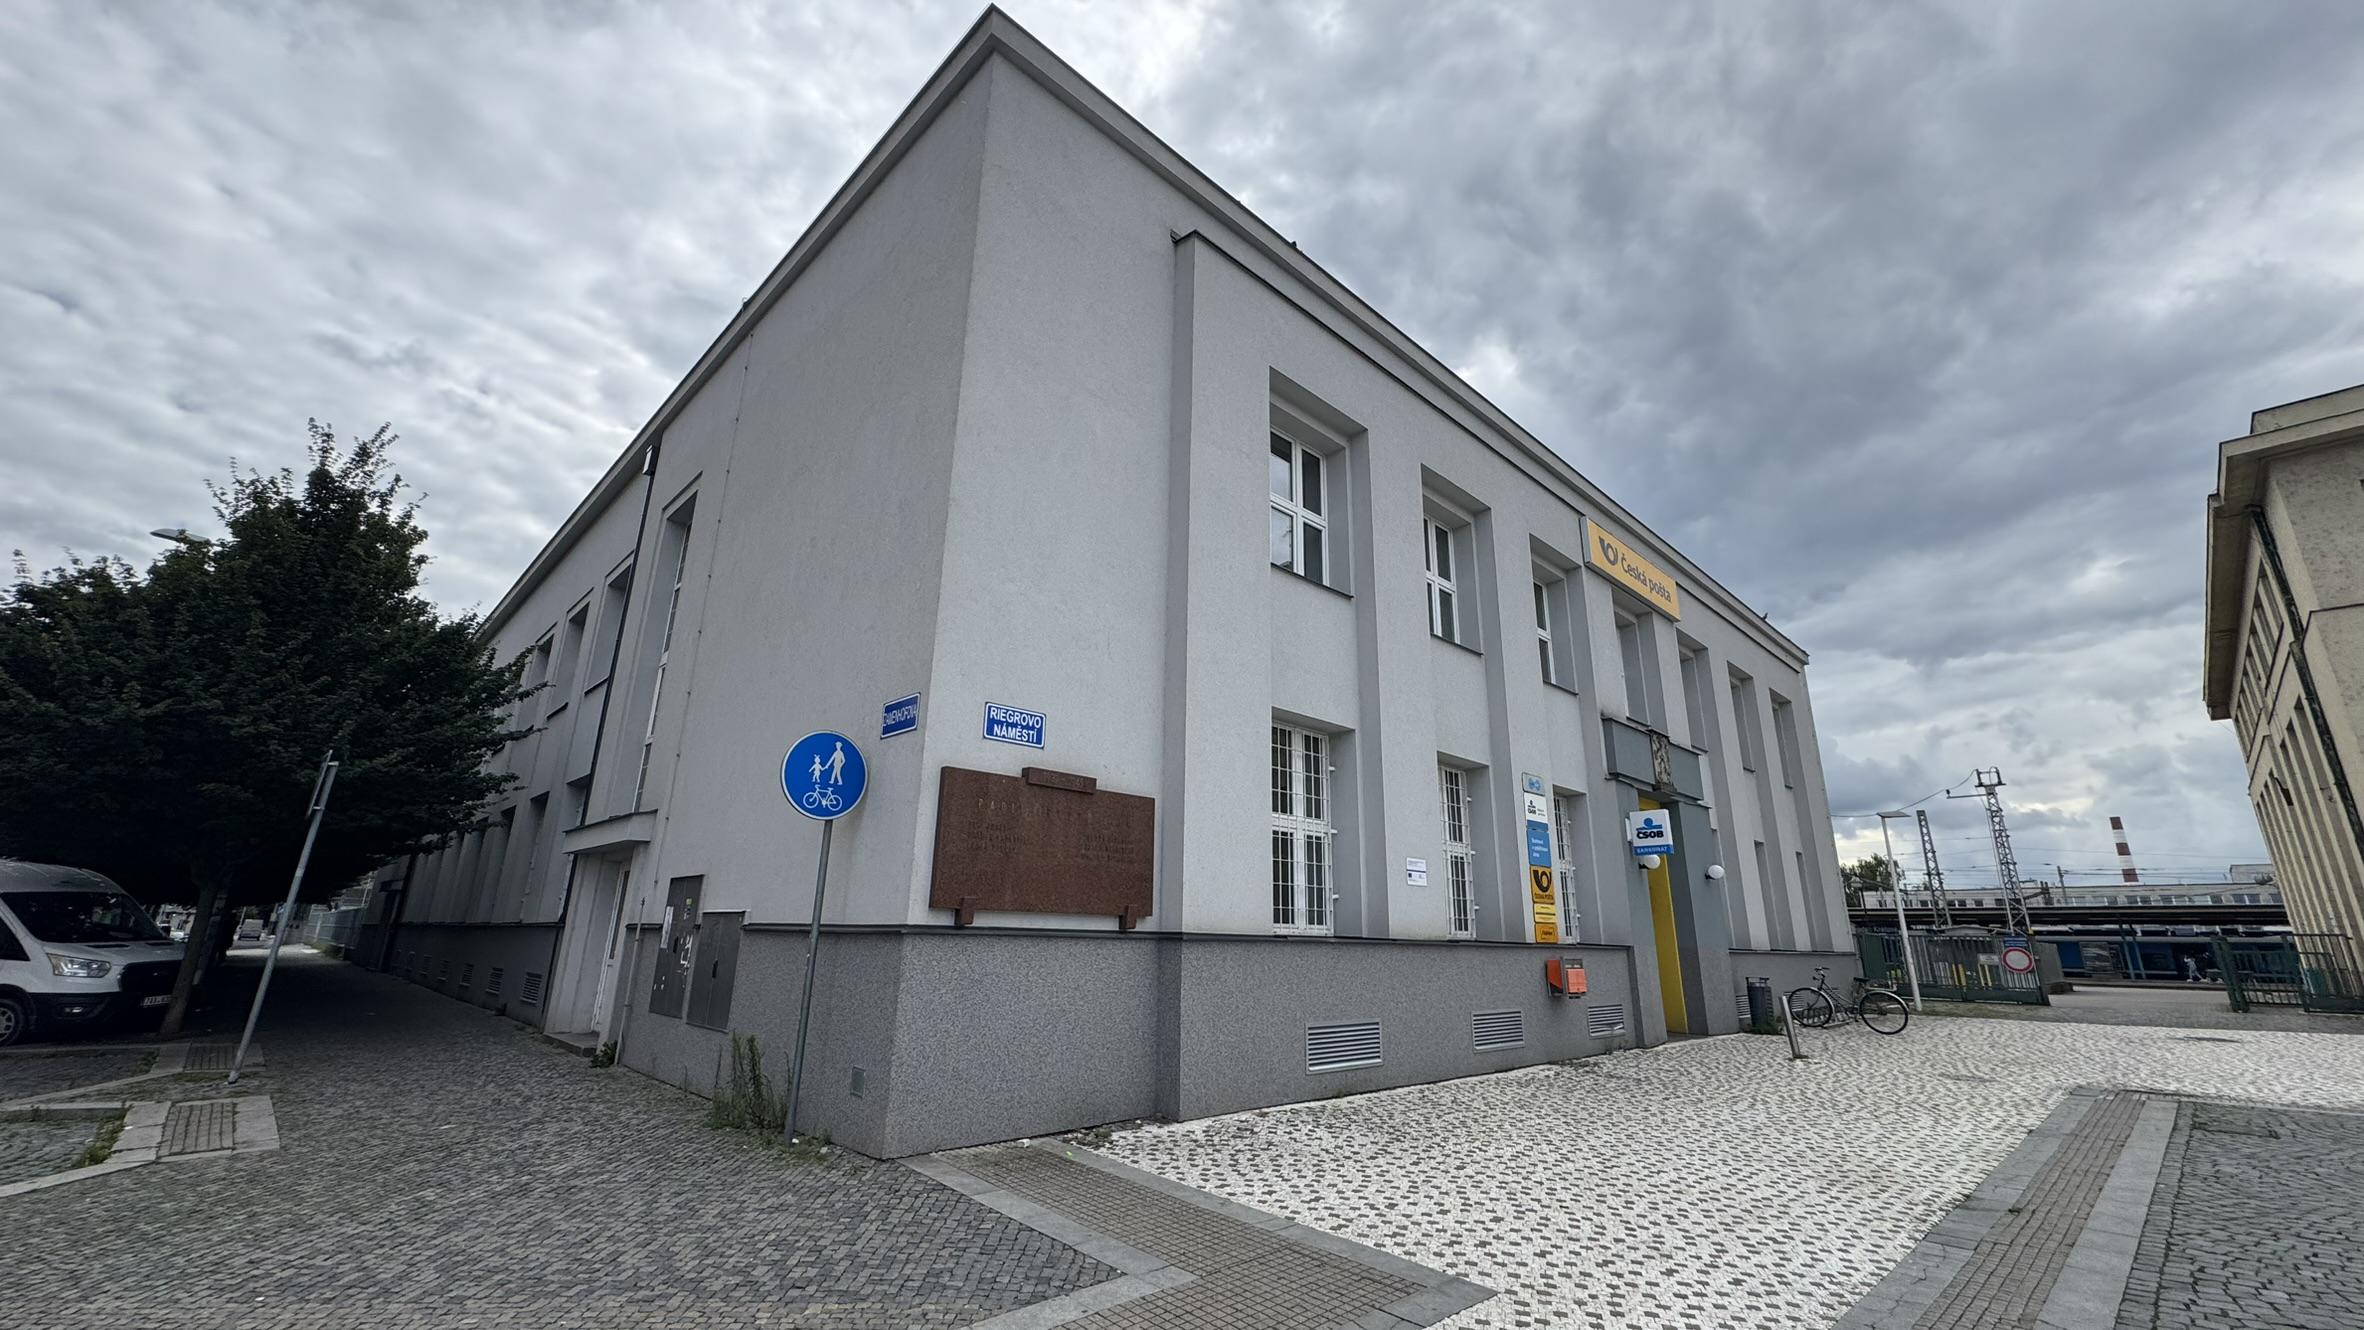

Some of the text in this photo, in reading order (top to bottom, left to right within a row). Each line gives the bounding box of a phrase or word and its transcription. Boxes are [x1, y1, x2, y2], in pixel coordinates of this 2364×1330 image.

[1621, 553, 1672, 602] Česká pošta
[990, 707, 1042, 728] RIEGROVO
[993, 722, 1037, 743] NÁMĚSTÍ
[1636, 829, 1664, 839] ČSOB
